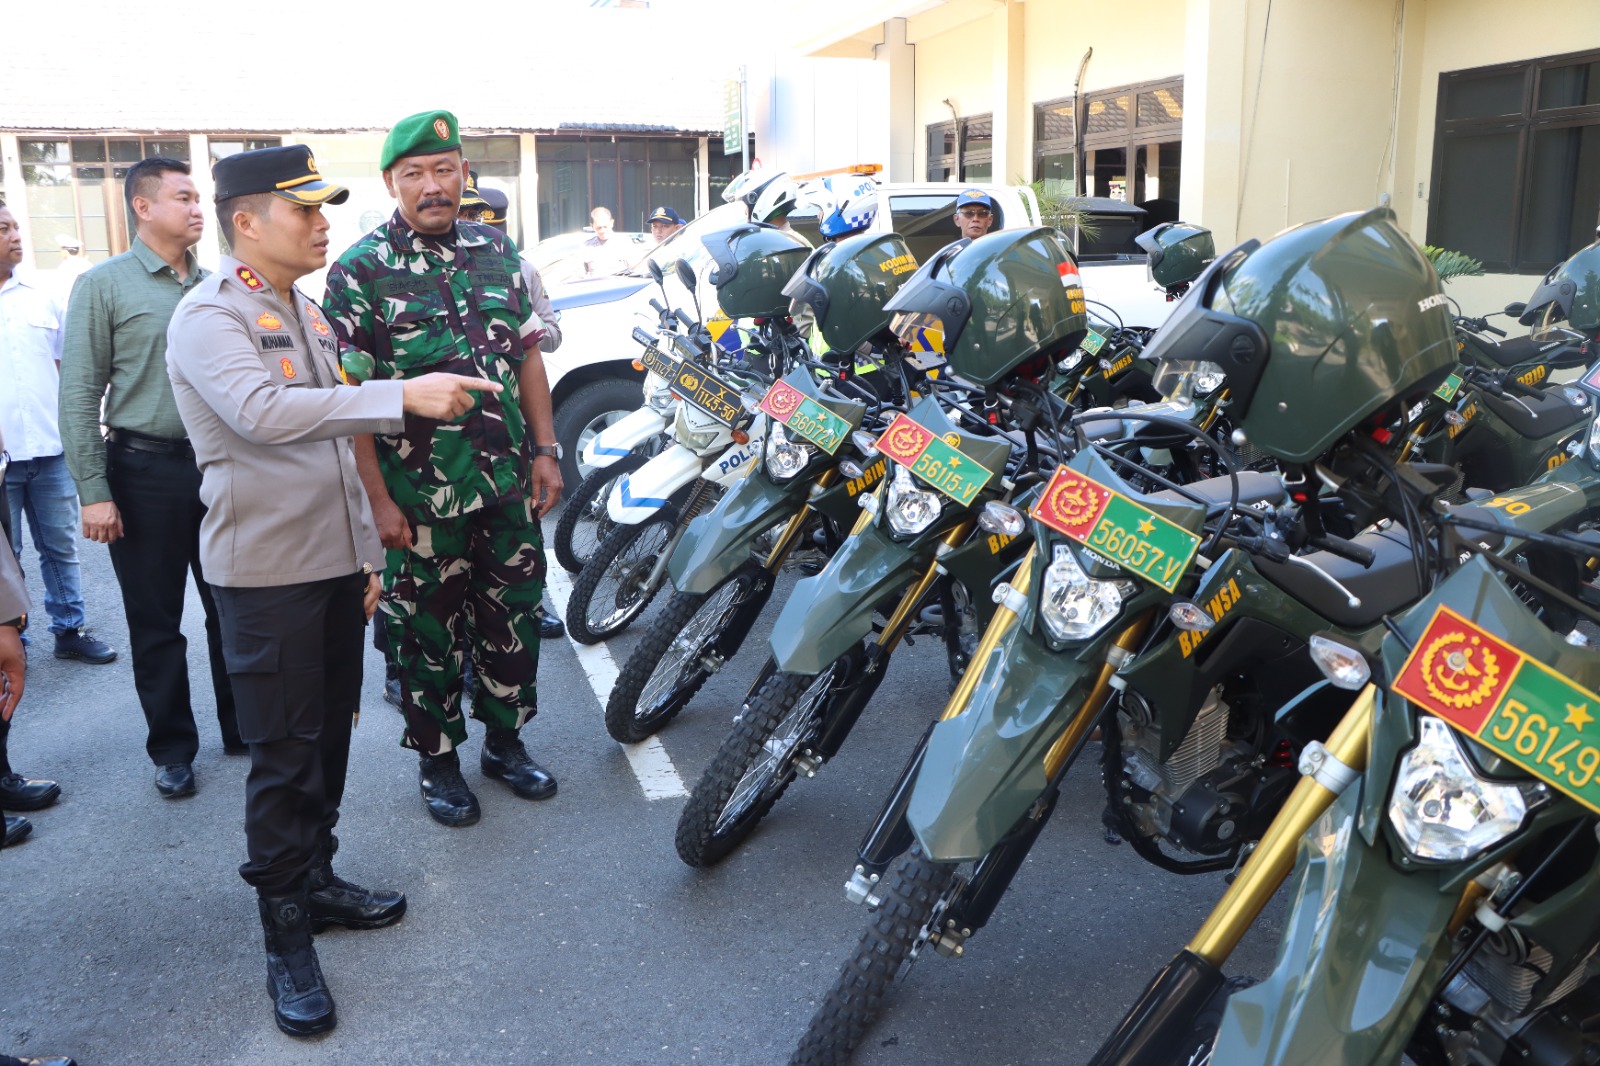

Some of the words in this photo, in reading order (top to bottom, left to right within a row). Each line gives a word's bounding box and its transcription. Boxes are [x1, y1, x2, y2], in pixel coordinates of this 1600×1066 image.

[260, 335, 294, 350] MUHAMMAD
[697, 391, 735, 421] 1145-50
[716, 387, 727, 399] X
[791, 411, 841, 449] 56072-V
[846, 458, 886, 497] BABIN
[917, 453, 978, 500] 56115-V
[1081, 546, 1121, 571] HONDA
[1093, 519, 1182, 583] 56057-V
[1178, 577, 1242, 659] BANSA
